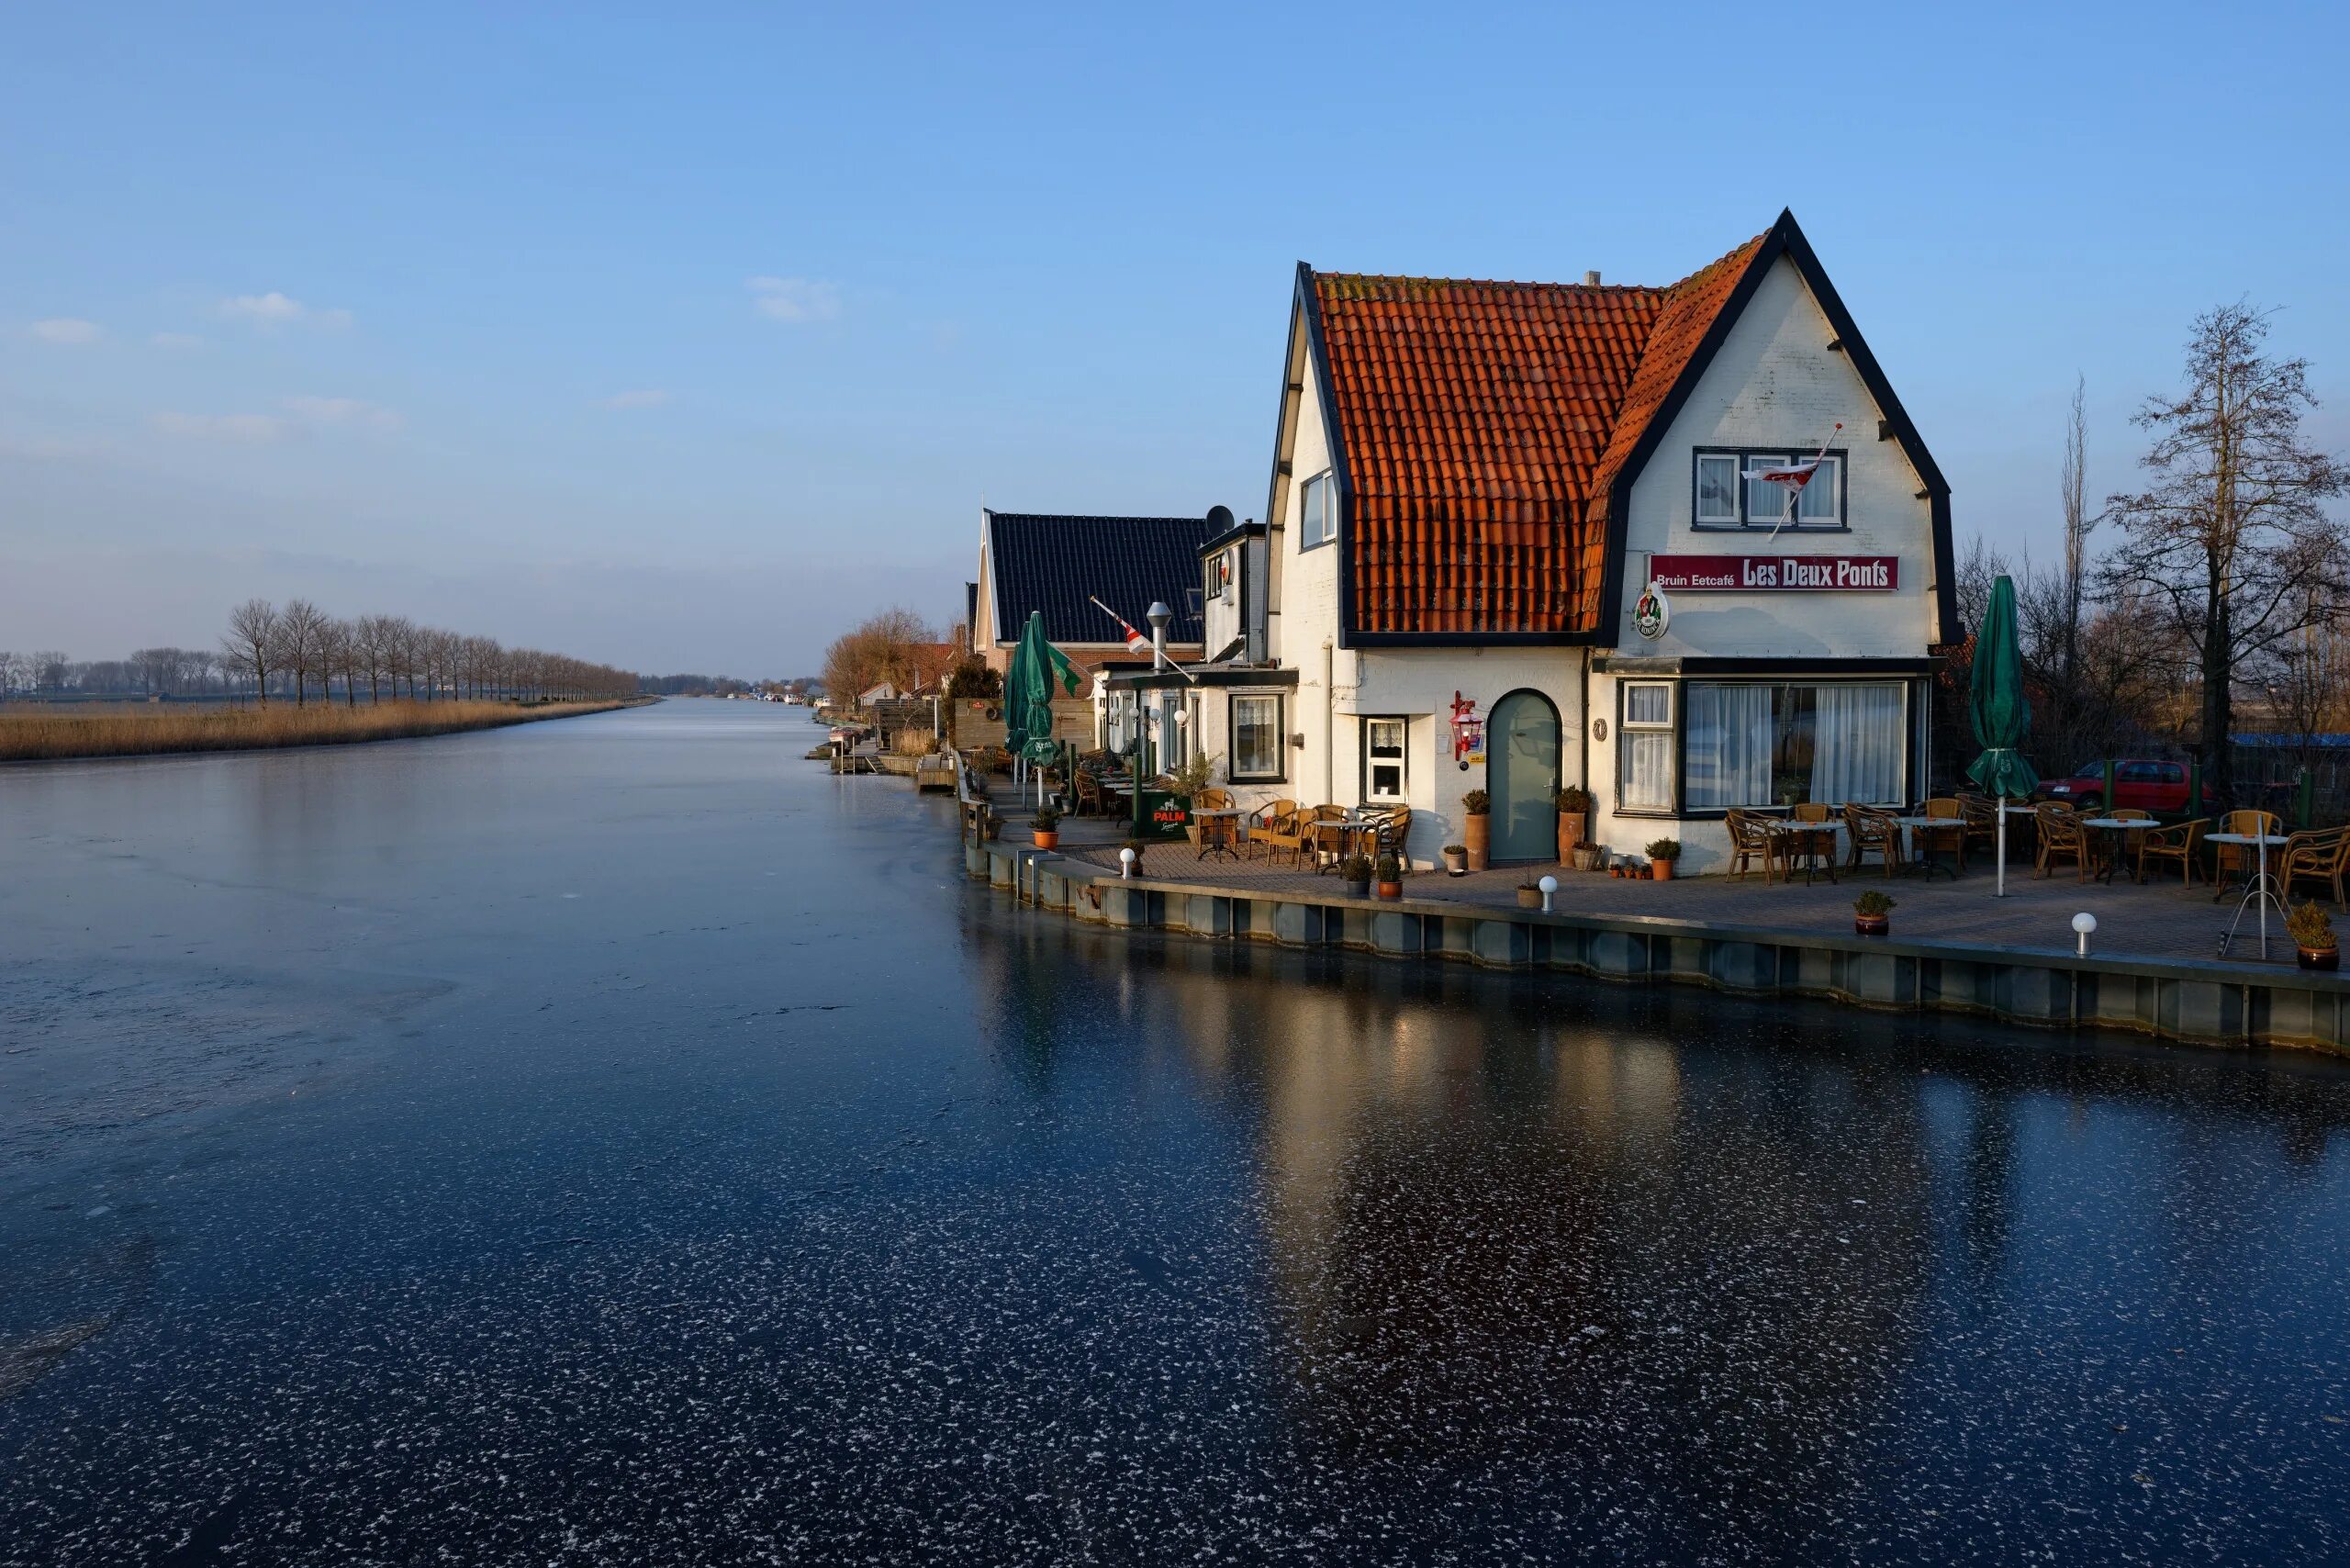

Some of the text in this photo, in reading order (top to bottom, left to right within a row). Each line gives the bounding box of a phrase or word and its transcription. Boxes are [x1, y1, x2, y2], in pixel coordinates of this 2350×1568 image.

[1657, 558, 1888, 587] Bruin Eetcafé Les Deux Ponts
[1153, 812, 1186, 823] PALM
